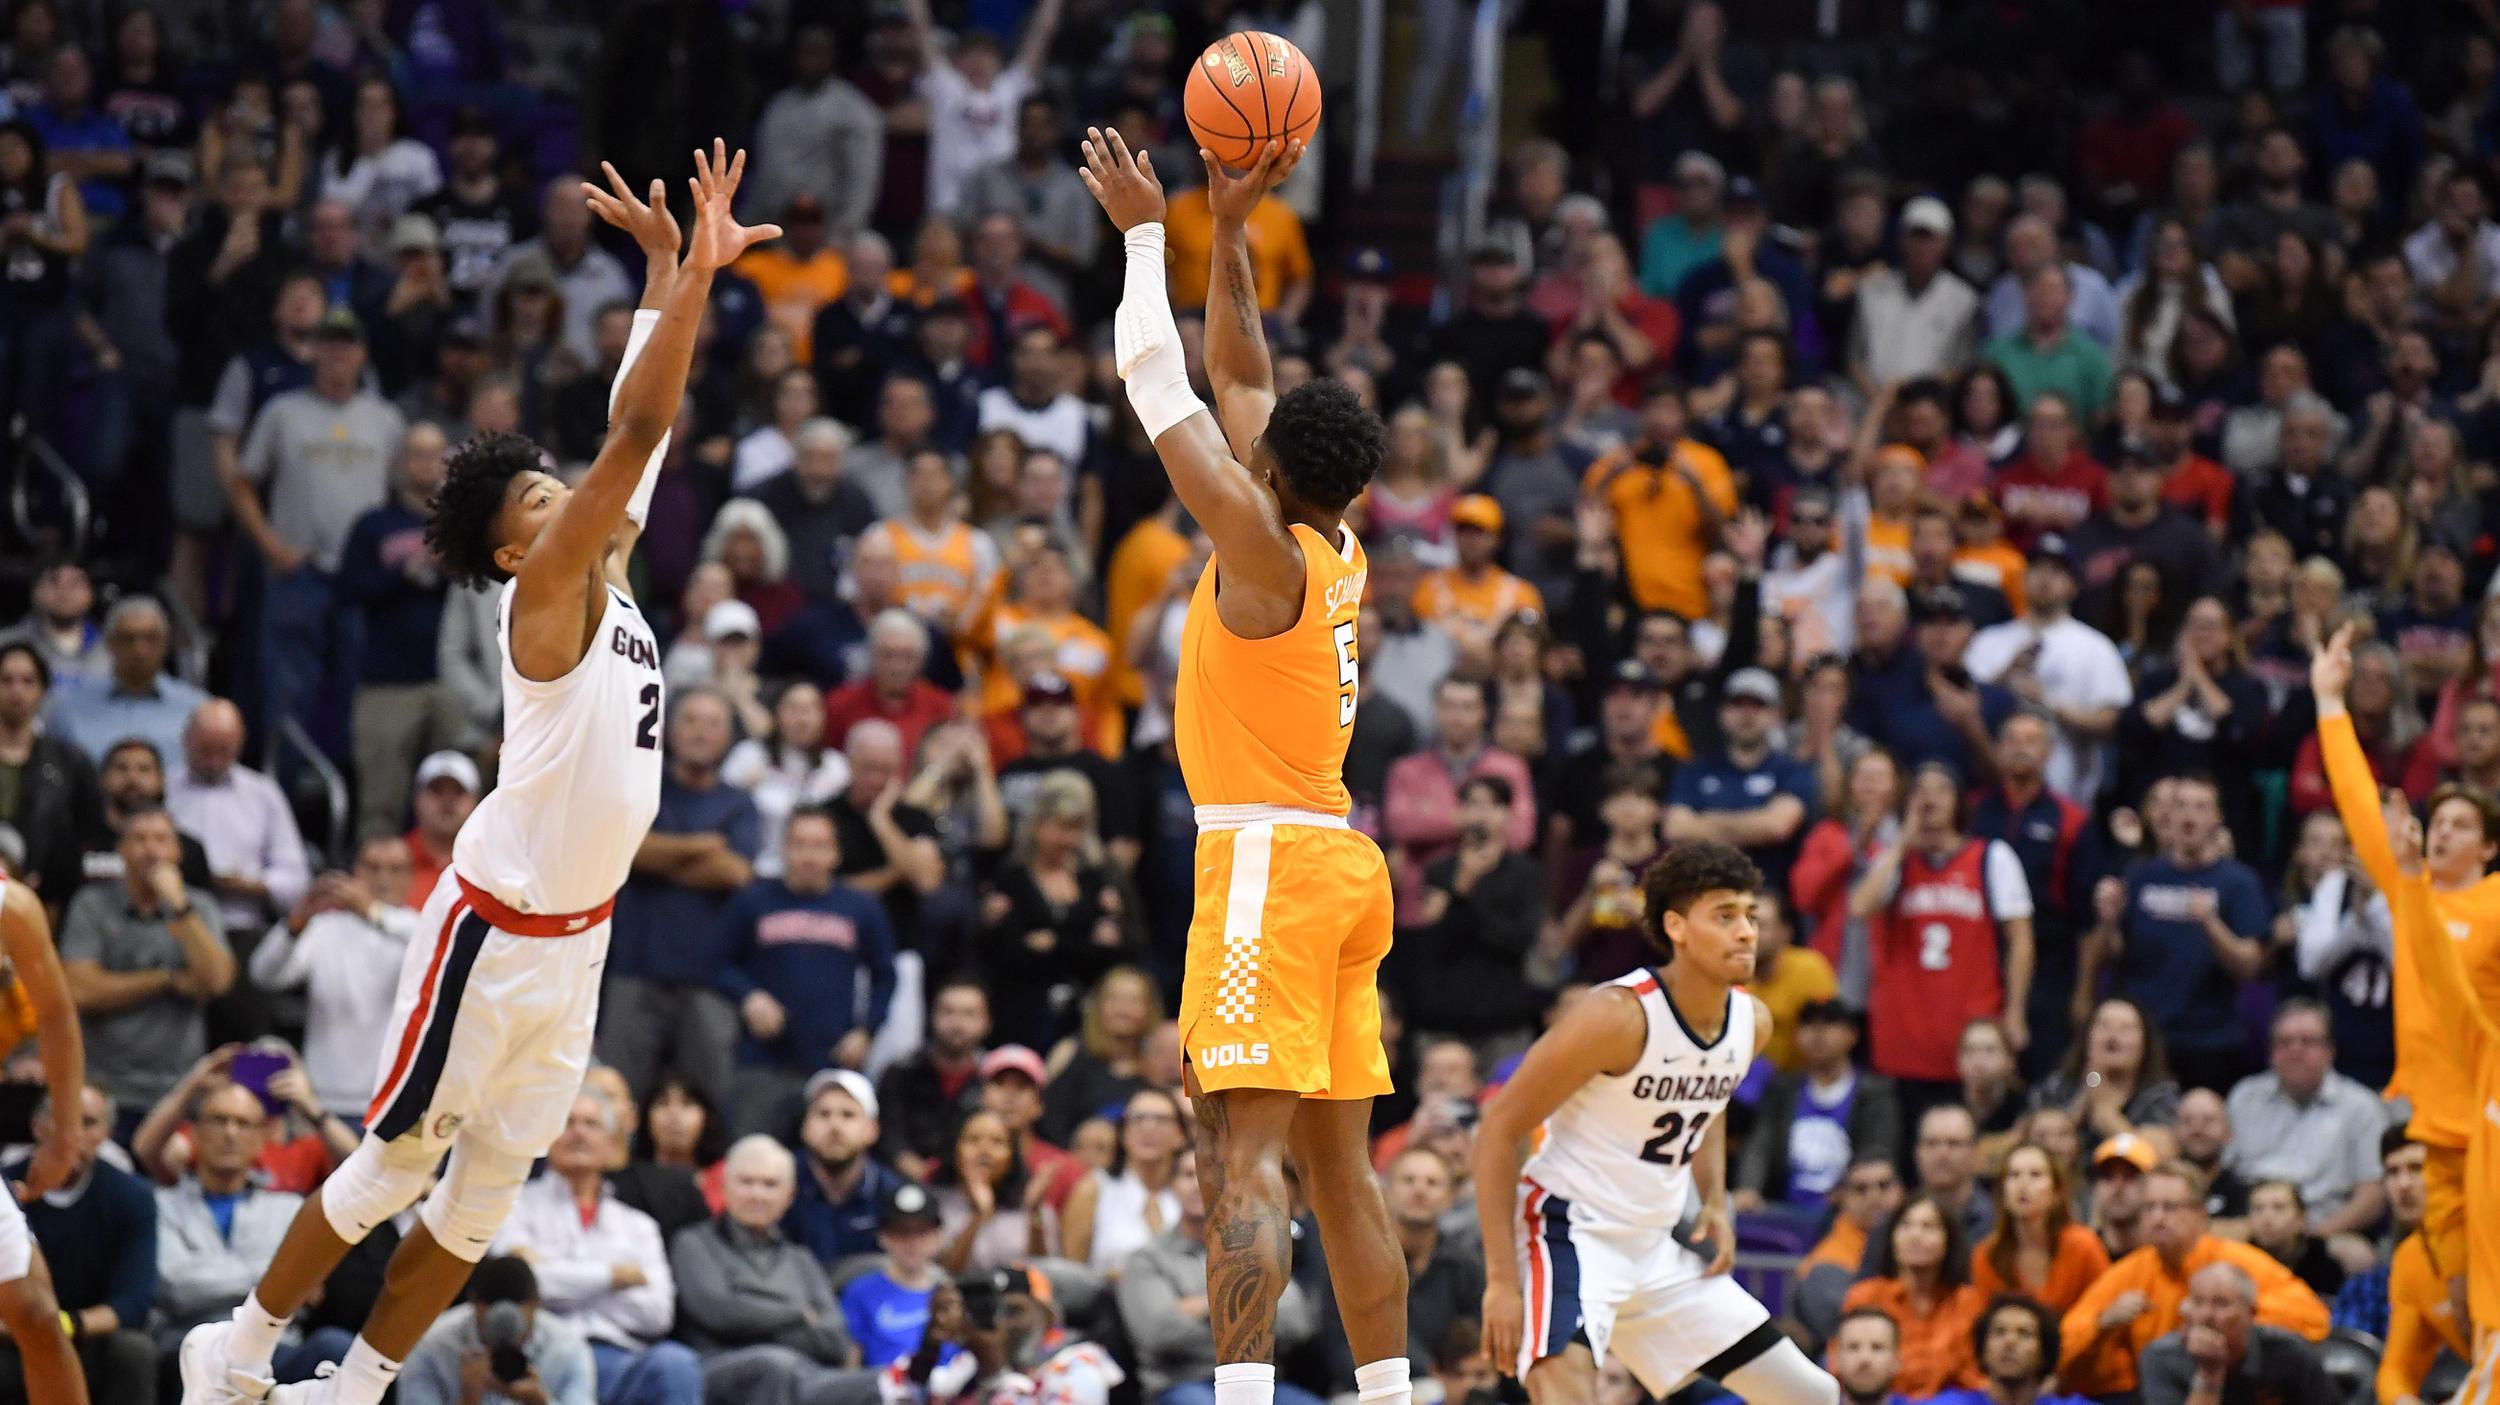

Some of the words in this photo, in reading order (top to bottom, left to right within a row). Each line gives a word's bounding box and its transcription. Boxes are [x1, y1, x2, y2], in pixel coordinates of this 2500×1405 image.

[1333, 620, 1359, 728] 5
[1920, 923, 1952, 970] 2
[1201, 1043, 1269, 1070] VOLS
